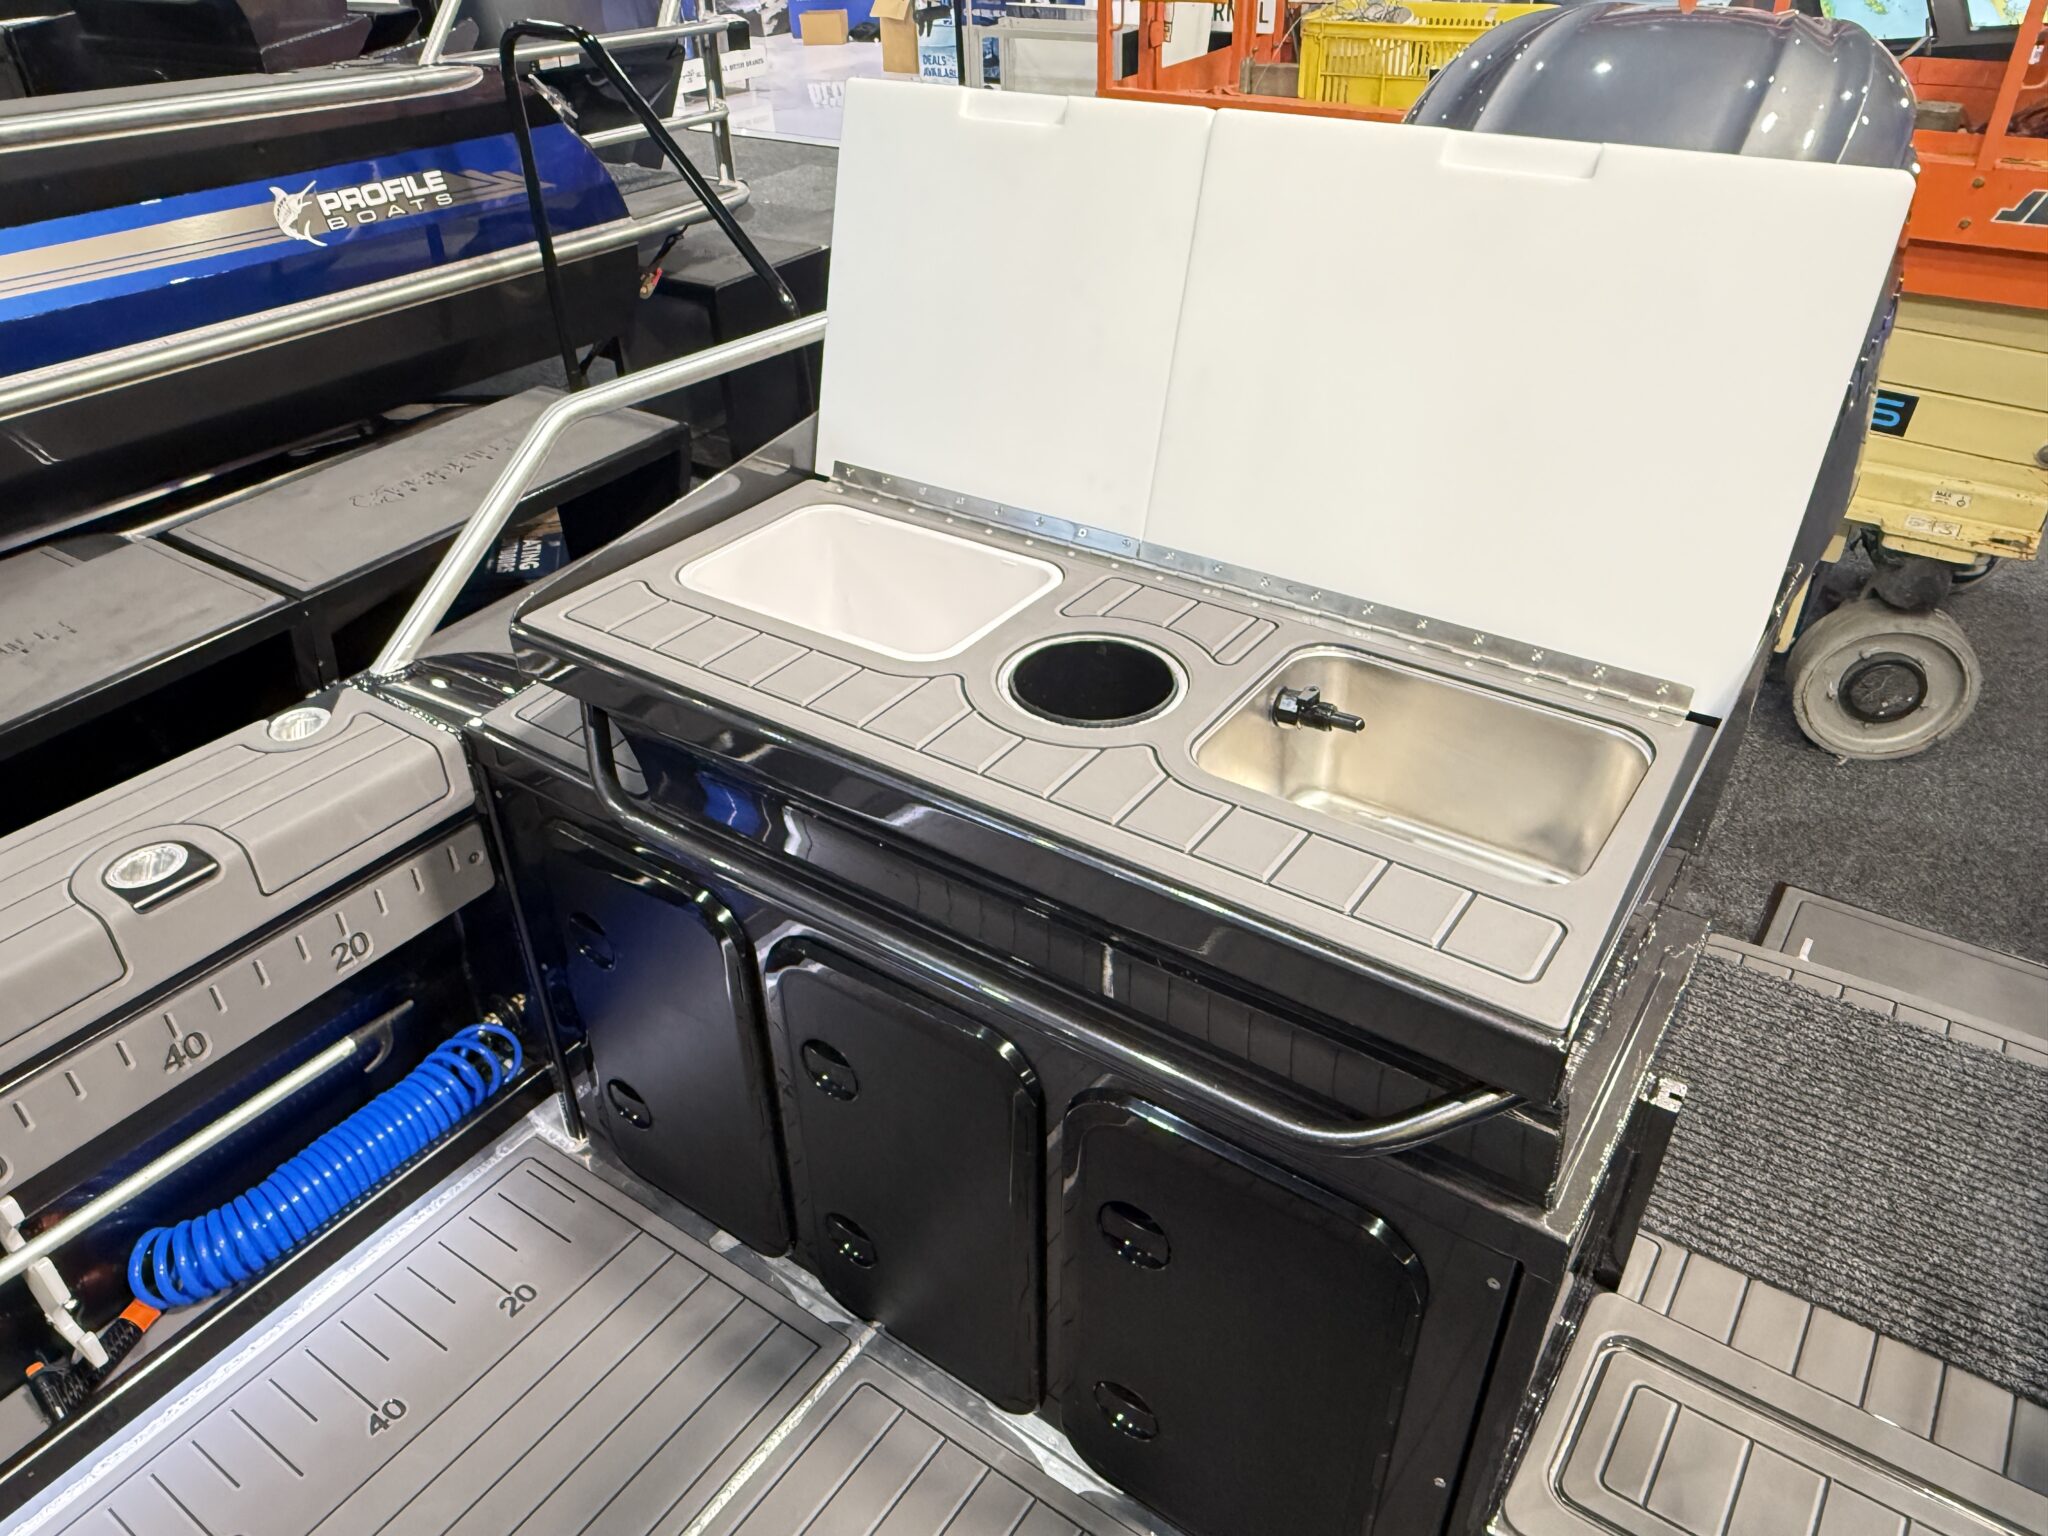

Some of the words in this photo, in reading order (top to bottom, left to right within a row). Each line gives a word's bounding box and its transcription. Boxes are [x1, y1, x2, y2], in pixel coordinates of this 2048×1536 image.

[922, 54, 947, 66] DEALS
[317, 170, 448, 216] PROFILE
[327, 193, 453, 231] BOATS
[331, 931, 370, 971] 20
[164, 1031, 208, 1071] 40
[499, 1284, 537, 1318] 20
[370, 1398, 407, 1436] 40
